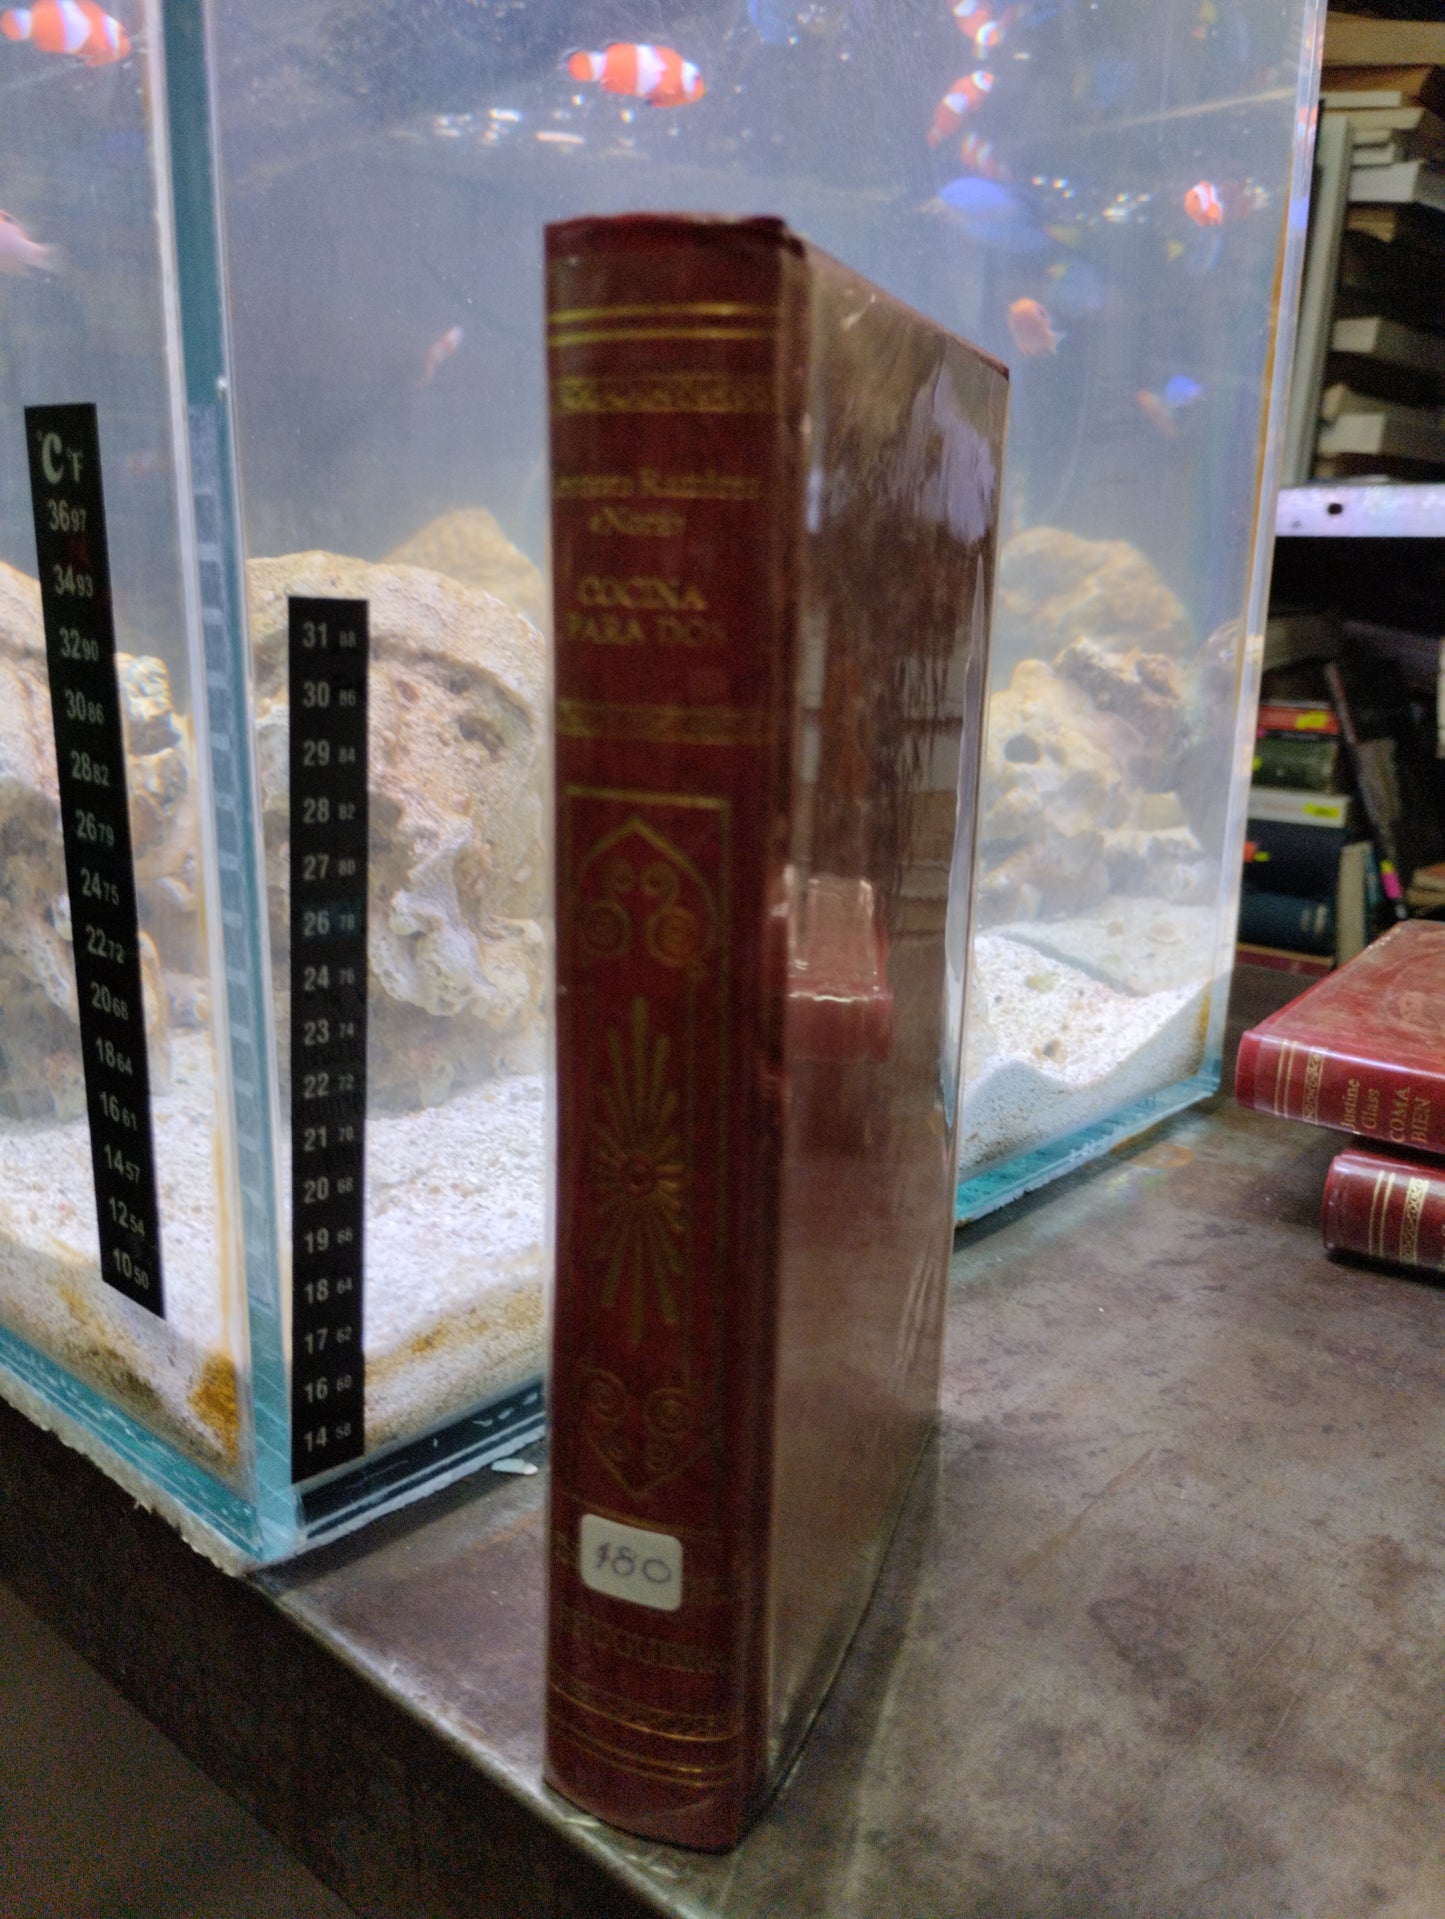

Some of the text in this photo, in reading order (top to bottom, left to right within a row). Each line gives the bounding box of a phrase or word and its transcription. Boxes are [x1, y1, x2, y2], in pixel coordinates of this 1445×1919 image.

[48, 499, 70, 531] 36
[54, 564, 77, 595] 34
[59, 627, 81, 659] 32
[303, 621, 327, 648] 31
[65, 689, 88, 721] 30
[303, 681, 330, 707] 30
[71, 750, 94, 781] 28
[304, 740, 330, 766] 29
[76, 809, 97, 841] 26
[304, 797, 329, 823] 28
[303, 854, 329, 880] 27
[81, 868, 102, 899] 24
[304, 910, 330, 936] 26
[86, 925, 107, 957] 22
[304, 965, 329, 991] 24
[91, 981, 113, 1013] 20
[304, 1018, 329, 1046] 23
[96, 1037, 116, 1068] 18
[304, 1072, 329, 1099] 22
[100, 1091, 120, 1122] 16
[1339, 1078, 1360, 1129] Justine
[1389, 1086, 1411, 1142] COMA
[1411, 1096, 1431, 1143] BIEN
[304, 1126, 327, 1151] 21
[104, 1144, 124, 1174] 14
[304, 1176, 329, 1204] 20
[109, 1197, 128, 1228] 12
[305, 1228, 329, 1253] 19
[113, 1248, 132, 1278] 10
[305, 1278, 329, 1303] 18
[305, 1328, 328, 1354] 17
[305, 1377, 328, 1402] 16
[305, 1426, 327, 1451] 14
[595, 1542, 673, 1584] 180
